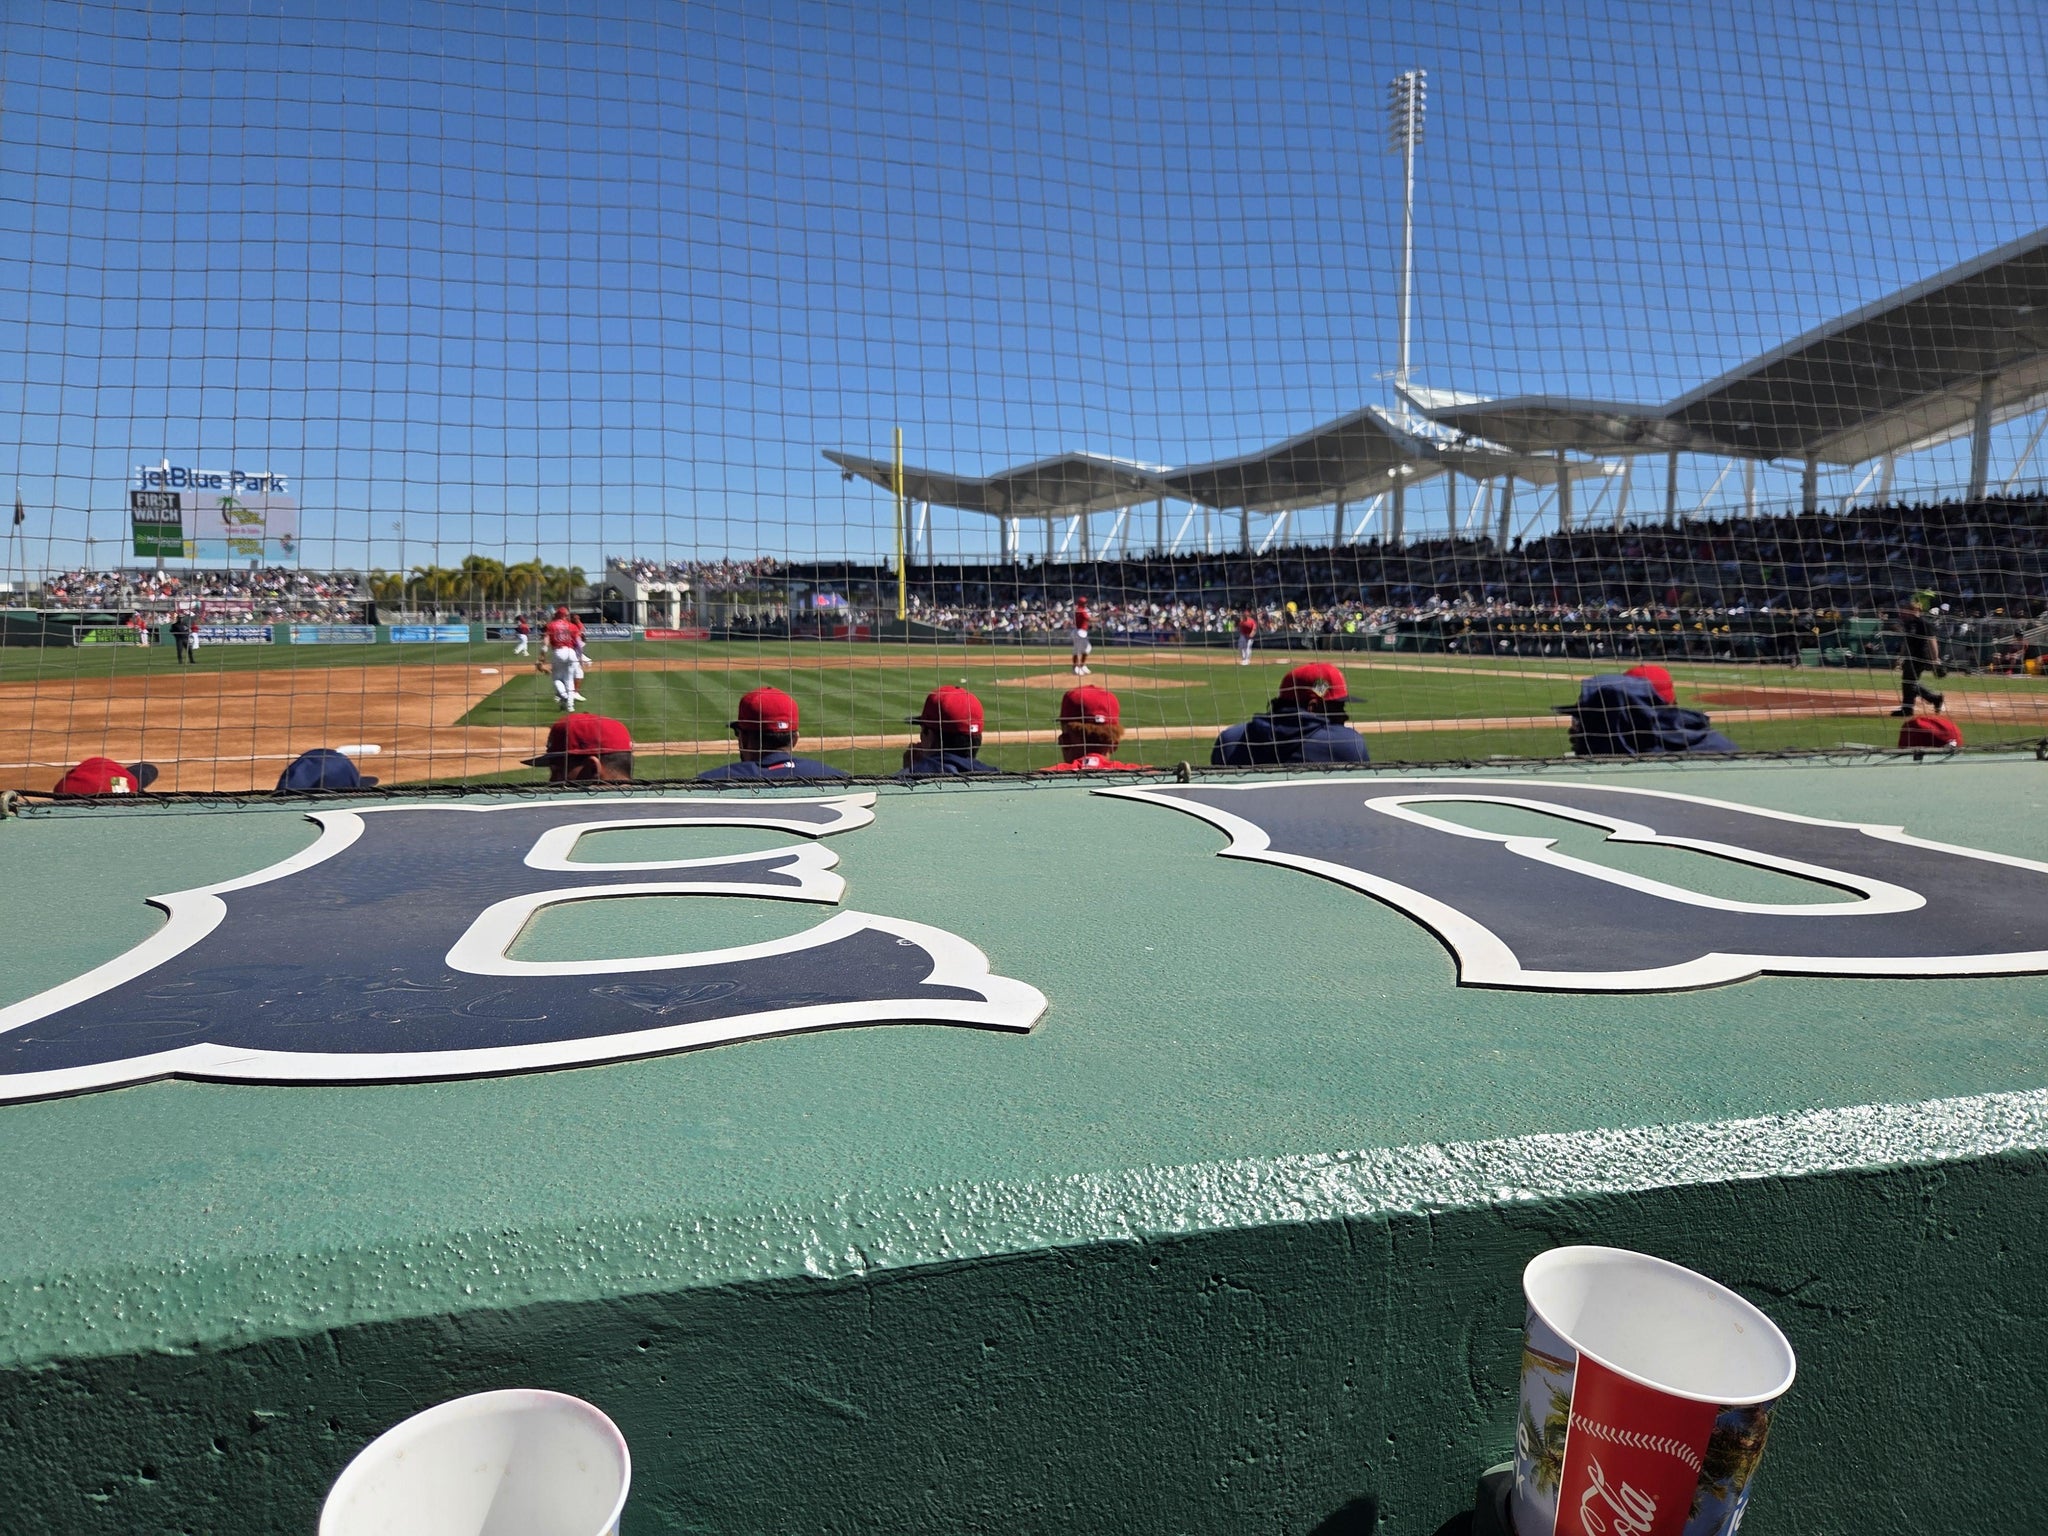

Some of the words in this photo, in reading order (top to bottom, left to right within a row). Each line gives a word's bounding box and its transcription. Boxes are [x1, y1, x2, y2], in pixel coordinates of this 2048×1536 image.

[141, 465, 222, 490] jetBlue
[231, 470, 285, 492] Park
[136, 493, 176, 508] FIRST
[134, 508, 179, 523] WATCH
